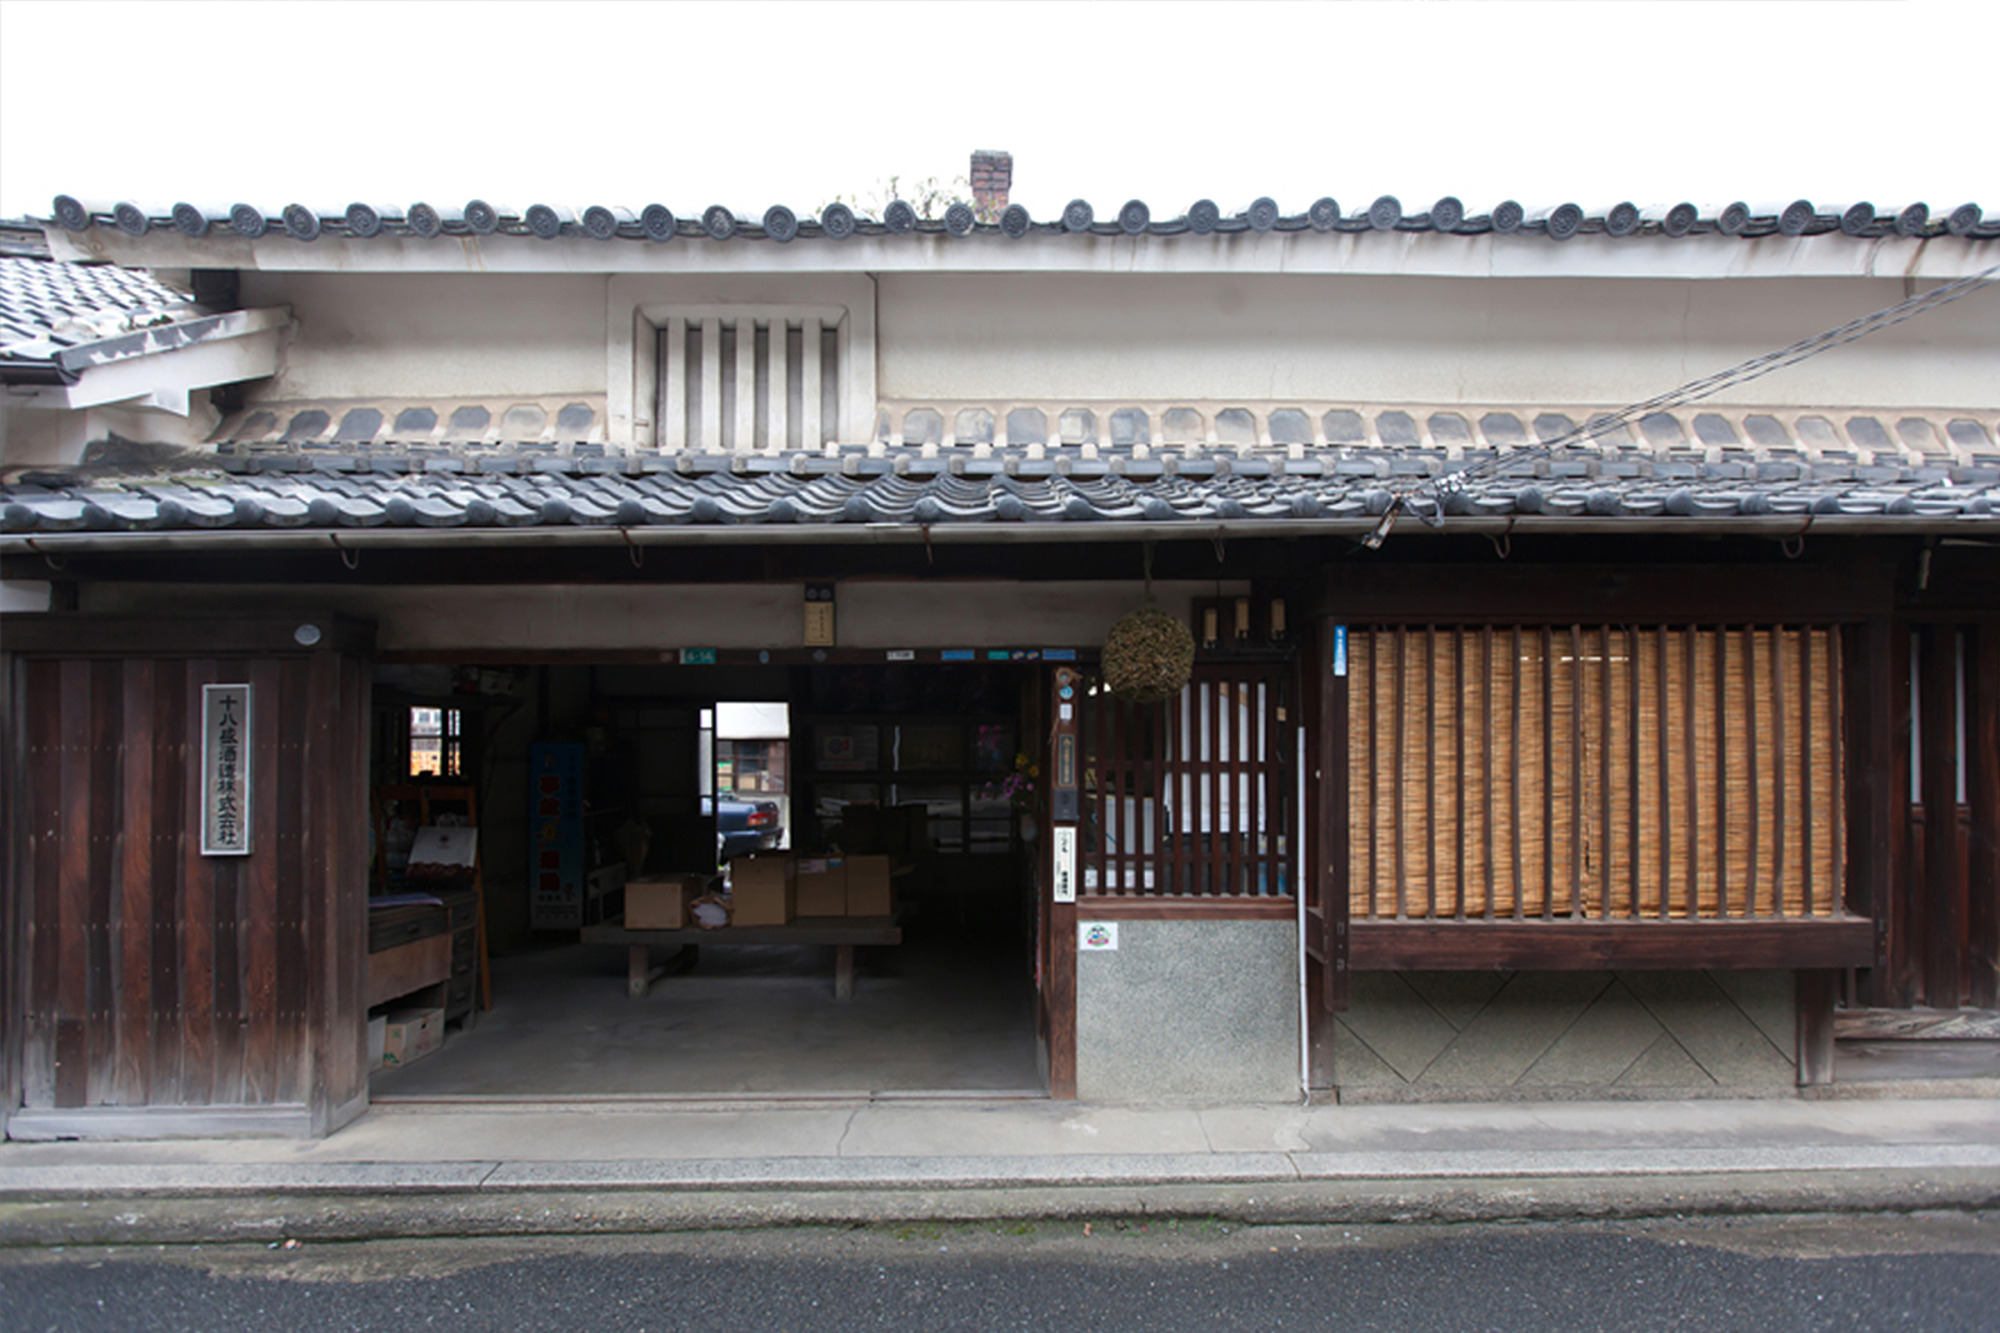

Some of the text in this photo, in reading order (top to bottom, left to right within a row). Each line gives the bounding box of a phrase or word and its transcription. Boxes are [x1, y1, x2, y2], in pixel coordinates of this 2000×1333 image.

[217, 694, 239, 846] 十八盛酒造株式会社
